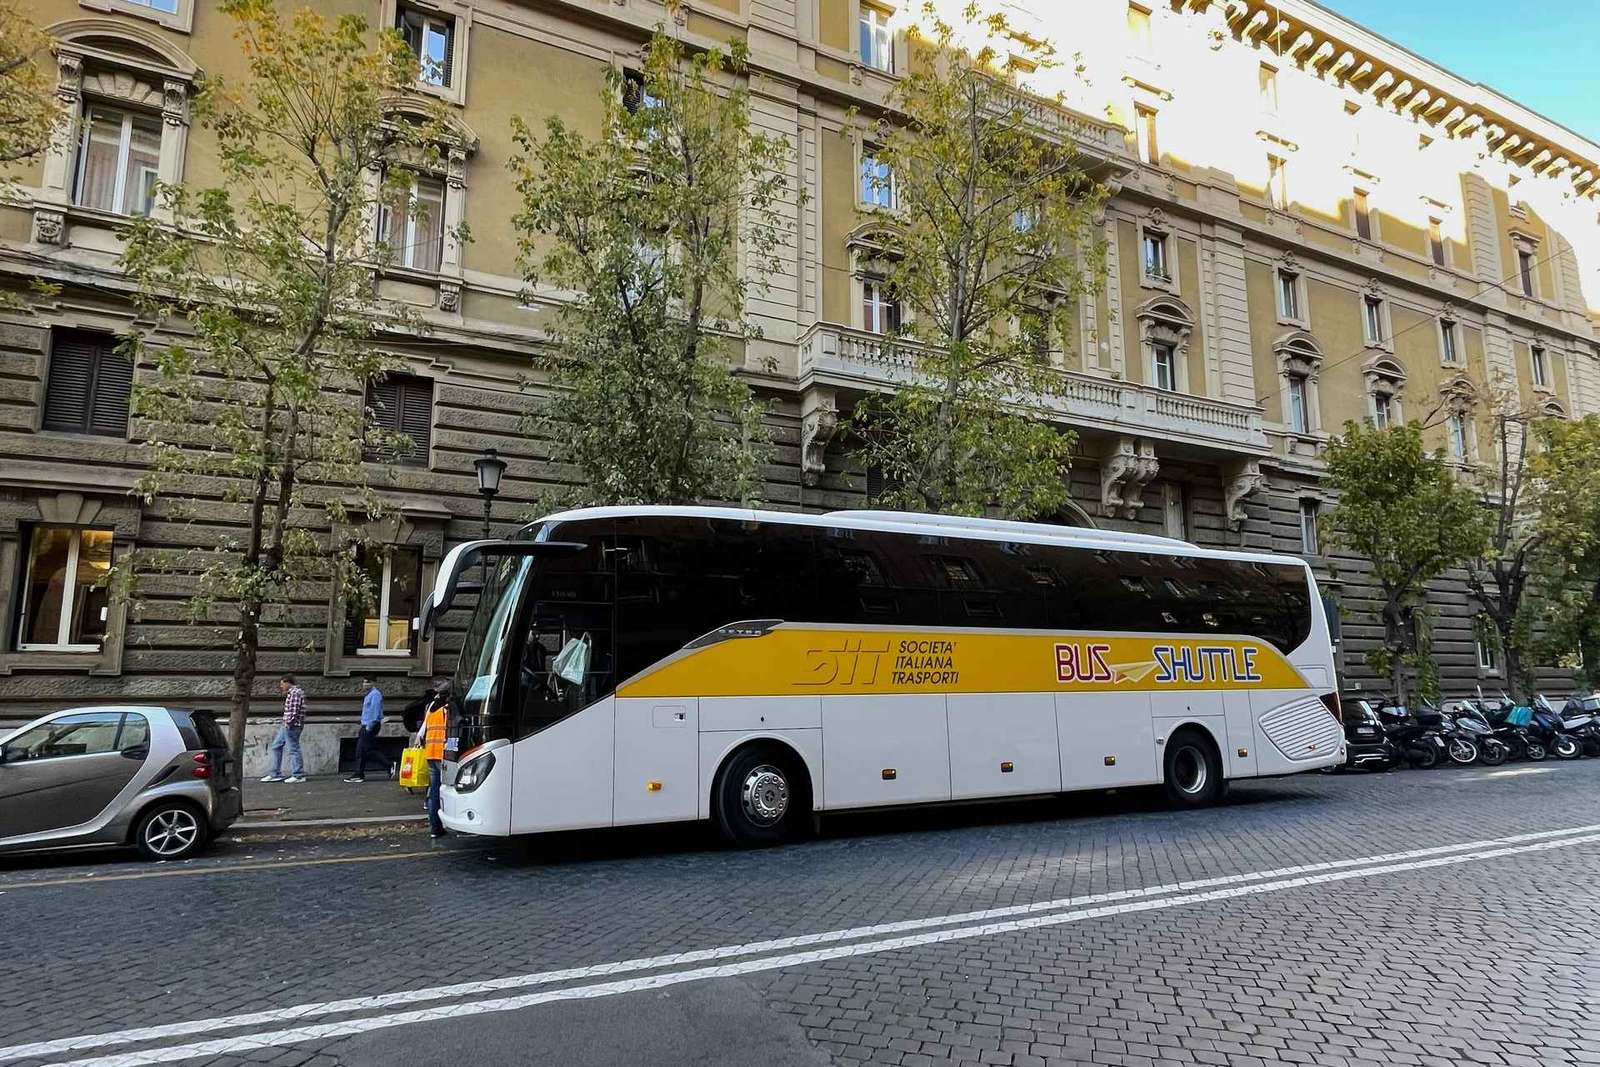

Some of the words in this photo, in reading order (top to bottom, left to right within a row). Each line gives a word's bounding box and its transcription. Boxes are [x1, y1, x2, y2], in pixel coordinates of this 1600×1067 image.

[898, 640, 957, 654] SOCIETA'
[895, 656, 953, 669] ITALIANA
[1054, 644, 1112, 683] BUS
[1153, 646, 1262, 682] SHUTTLE
[892, 671, 959, 685] TRASPORTI
